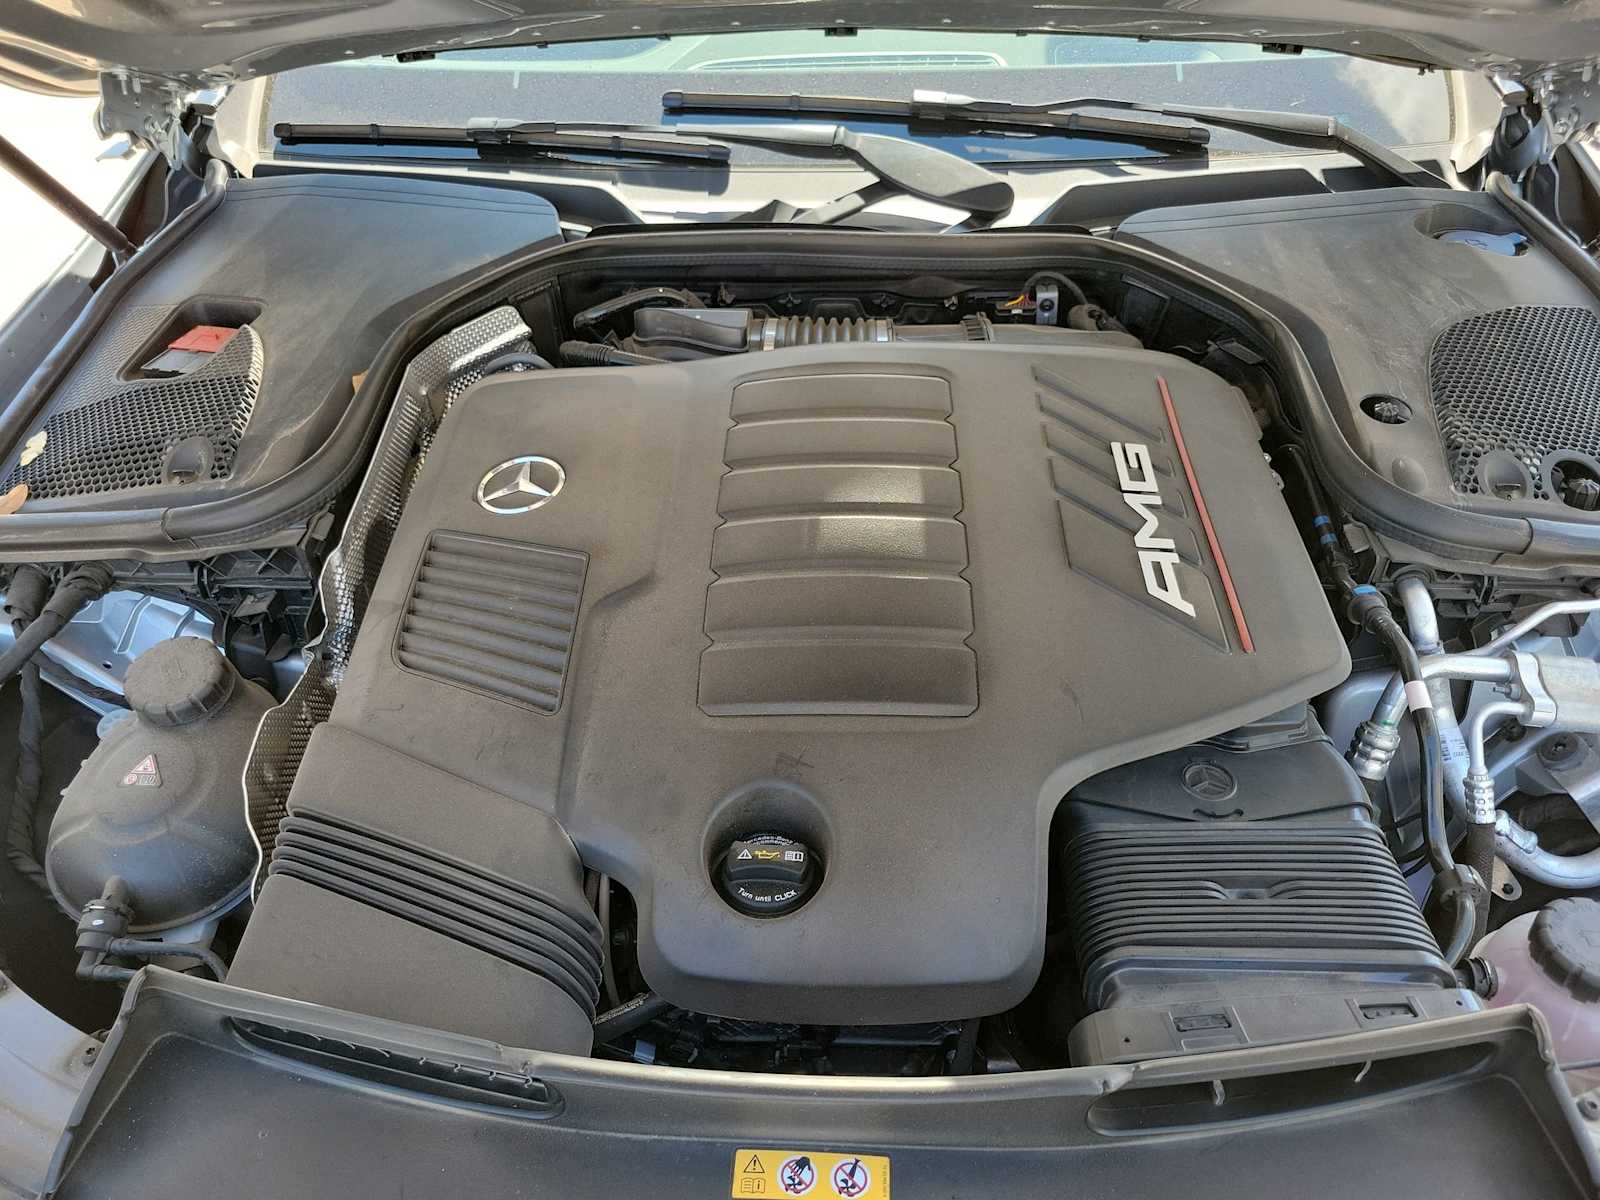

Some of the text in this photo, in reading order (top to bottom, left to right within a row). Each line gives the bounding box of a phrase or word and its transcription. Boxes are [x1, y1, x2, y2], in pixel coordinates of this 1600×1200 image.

[1110, 441, 1196, 618] AMG
[738, 887, 753, 899] Turn
[774, 889, 797, 902] CLICK
